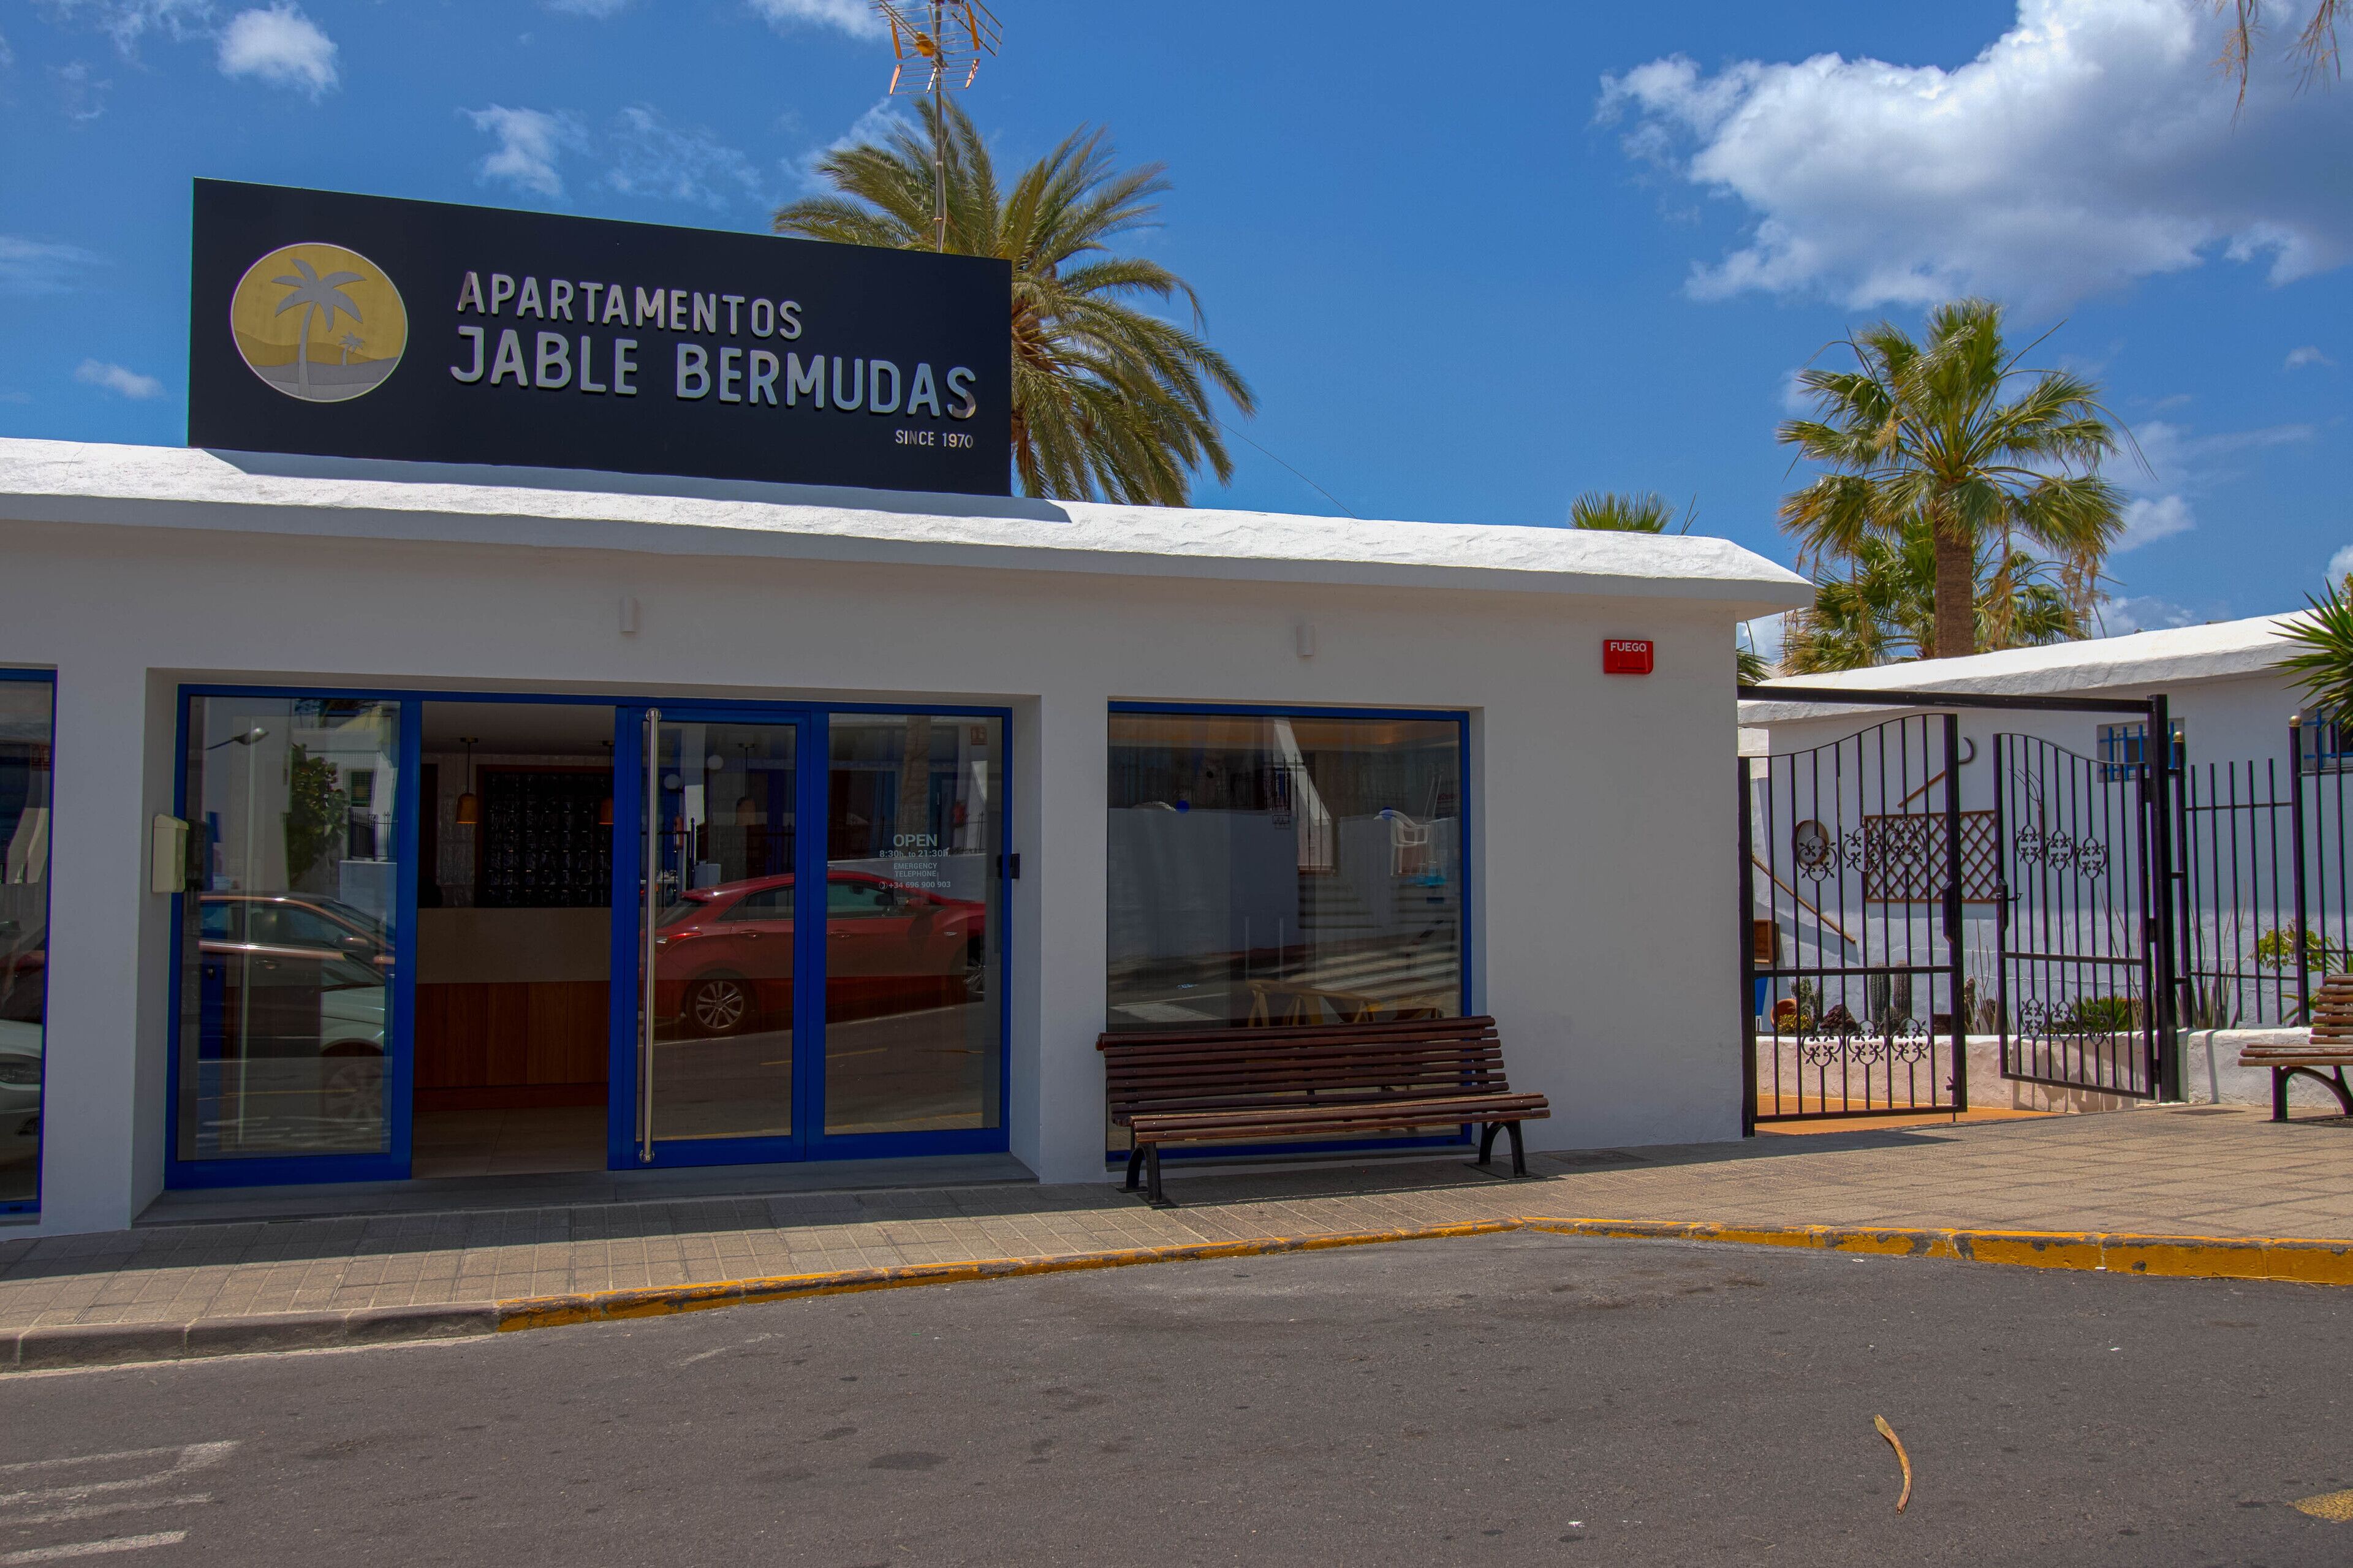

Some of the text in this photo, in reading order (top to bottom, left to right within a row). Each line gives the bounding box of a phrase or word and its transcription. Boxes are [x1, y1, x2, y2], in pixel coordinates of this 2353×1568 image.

[457, 271, 803, 341] APARTAMENTOS
[450, 325, 977, 420] JABLE BERMUDAS
[895, 430, 974, 449] SINCE 1970
[1610, 642, 1647, 653] FUEGO
[892, 834, 938, 847] OPEN
